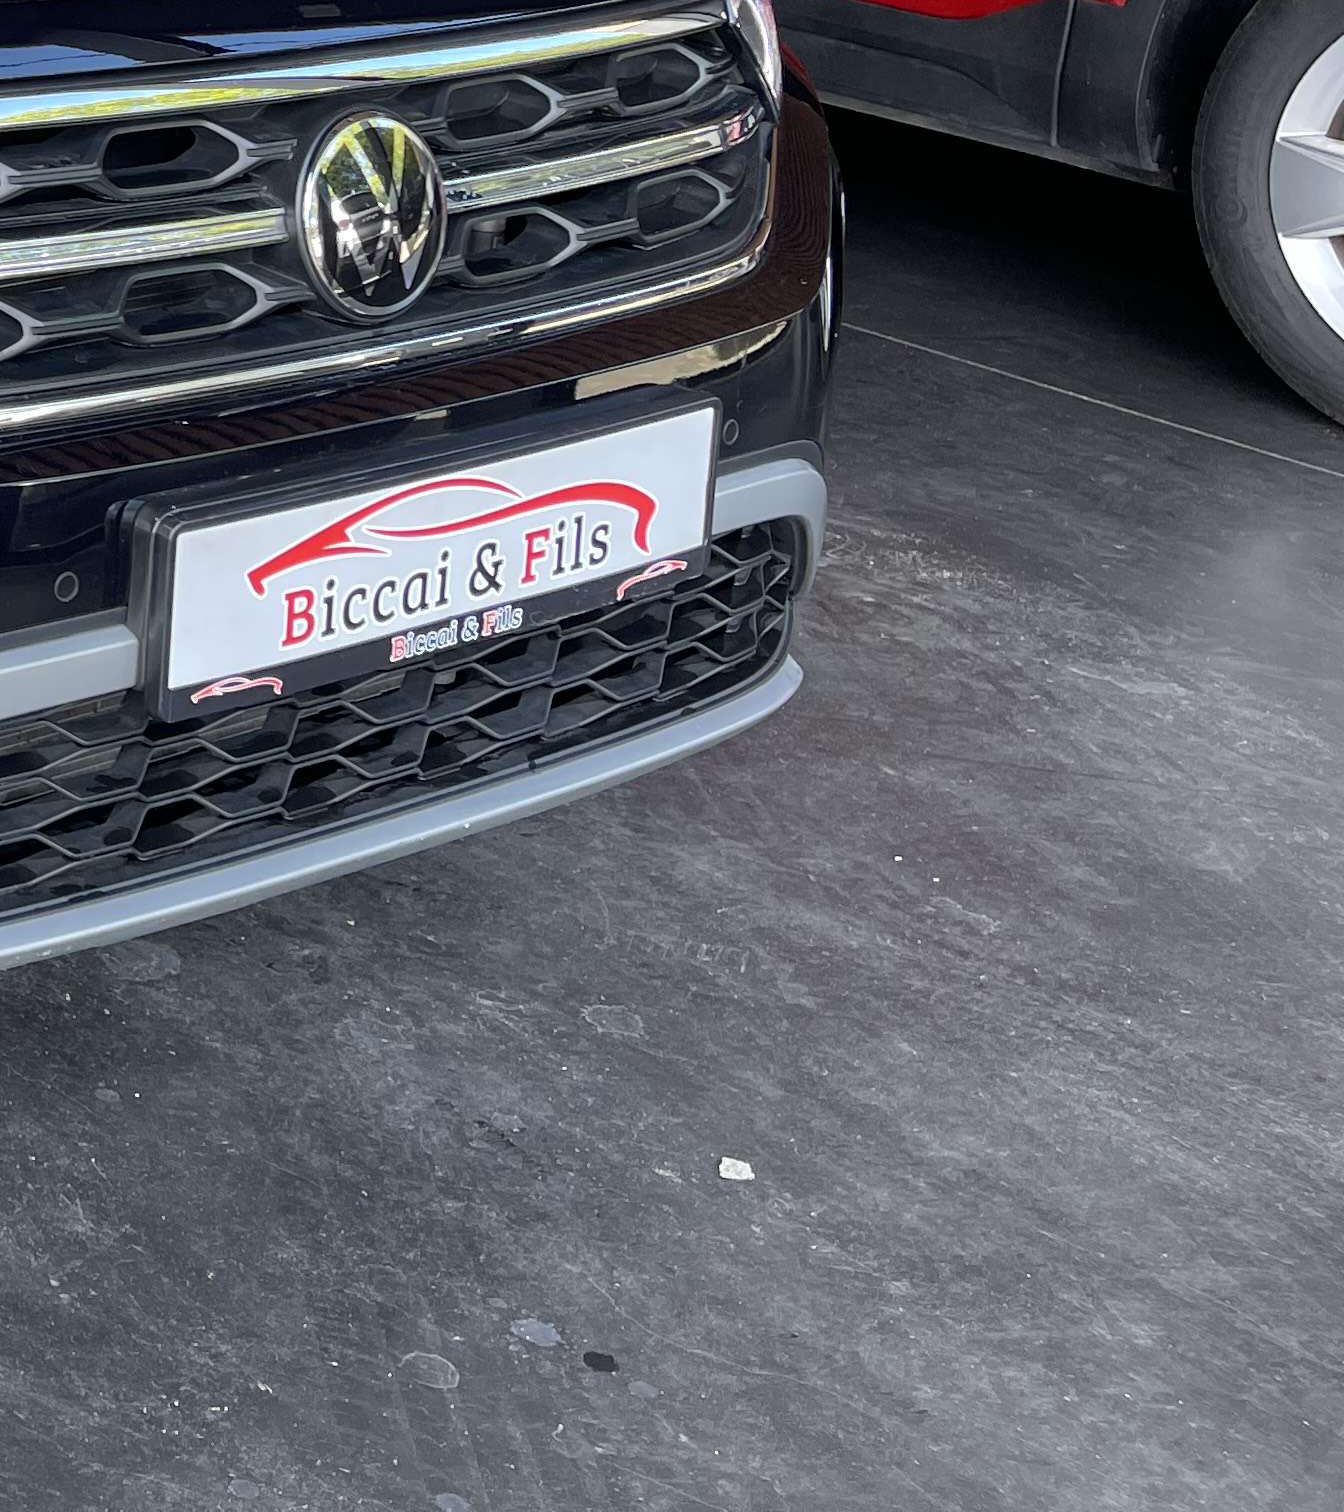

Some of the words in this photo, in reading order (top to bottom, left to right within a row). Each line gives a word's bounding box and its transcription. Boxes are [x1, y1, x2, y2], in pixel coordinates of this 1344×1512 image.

[282, 550, 450, 646] Biccai
[468, 542, 505, 596] &
[520, 515, 609, 584] Fils
[390, 617, 459, 663] Biccai
[461, 613, 480, 641] &
[480, 604, 523, 638] Fils
